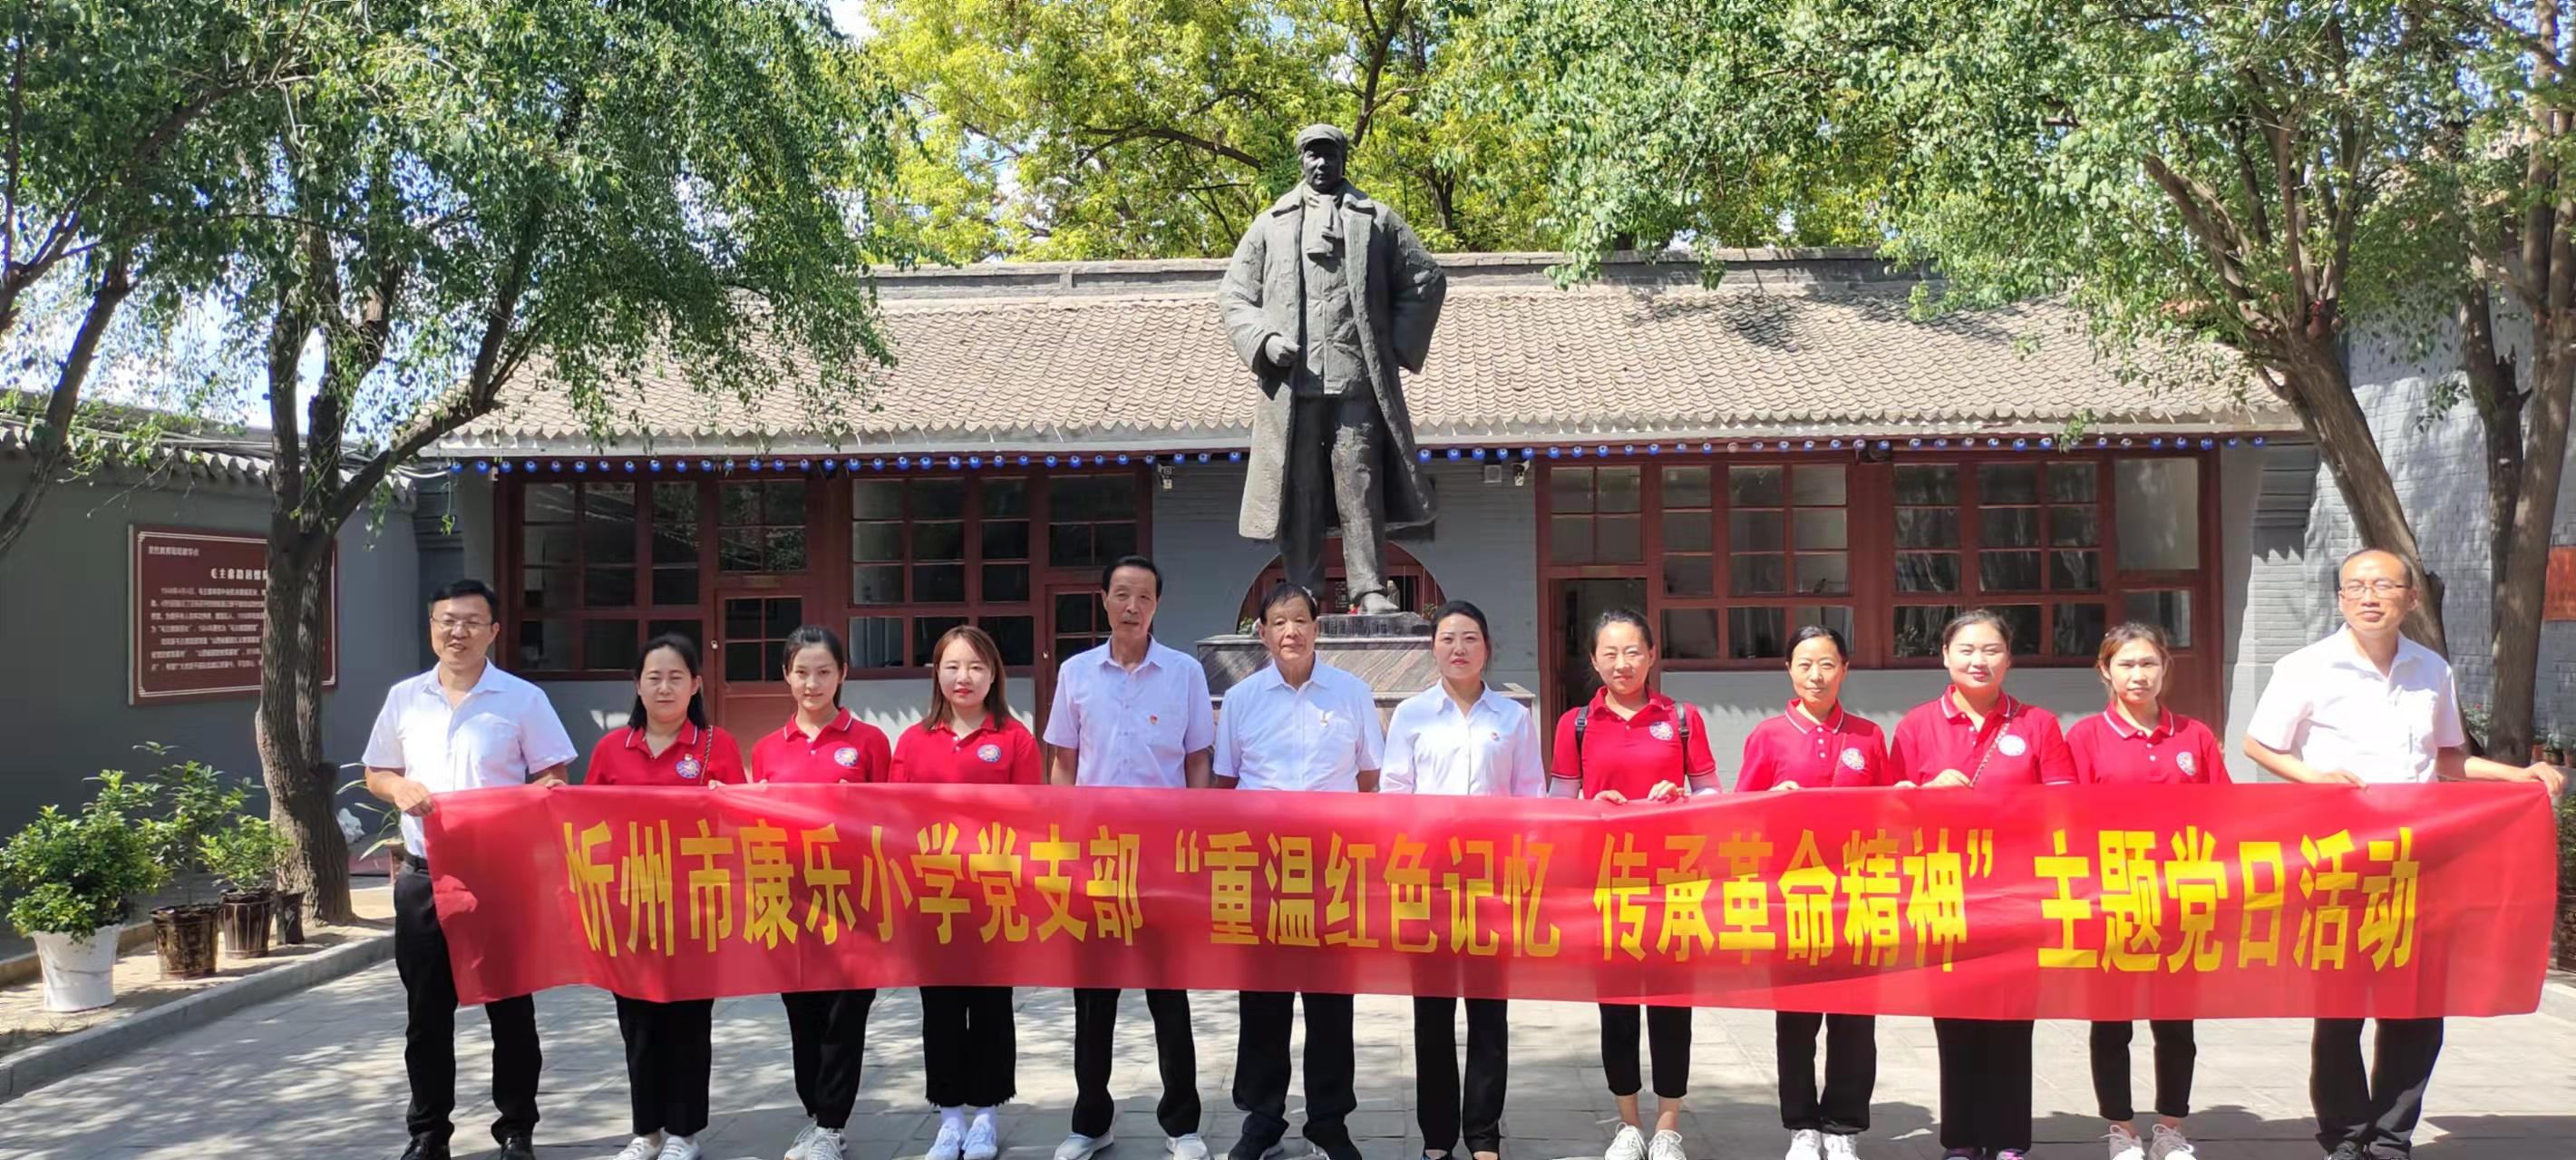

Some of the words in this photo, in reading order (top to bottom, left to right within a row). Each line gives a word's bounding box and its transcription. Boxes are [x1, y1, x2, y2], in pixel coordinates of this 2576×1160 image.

[564, 818, 1143, 957] 忻州市康乐小学党支部
[2034, 825, 2419, 973] 主题党日活动
